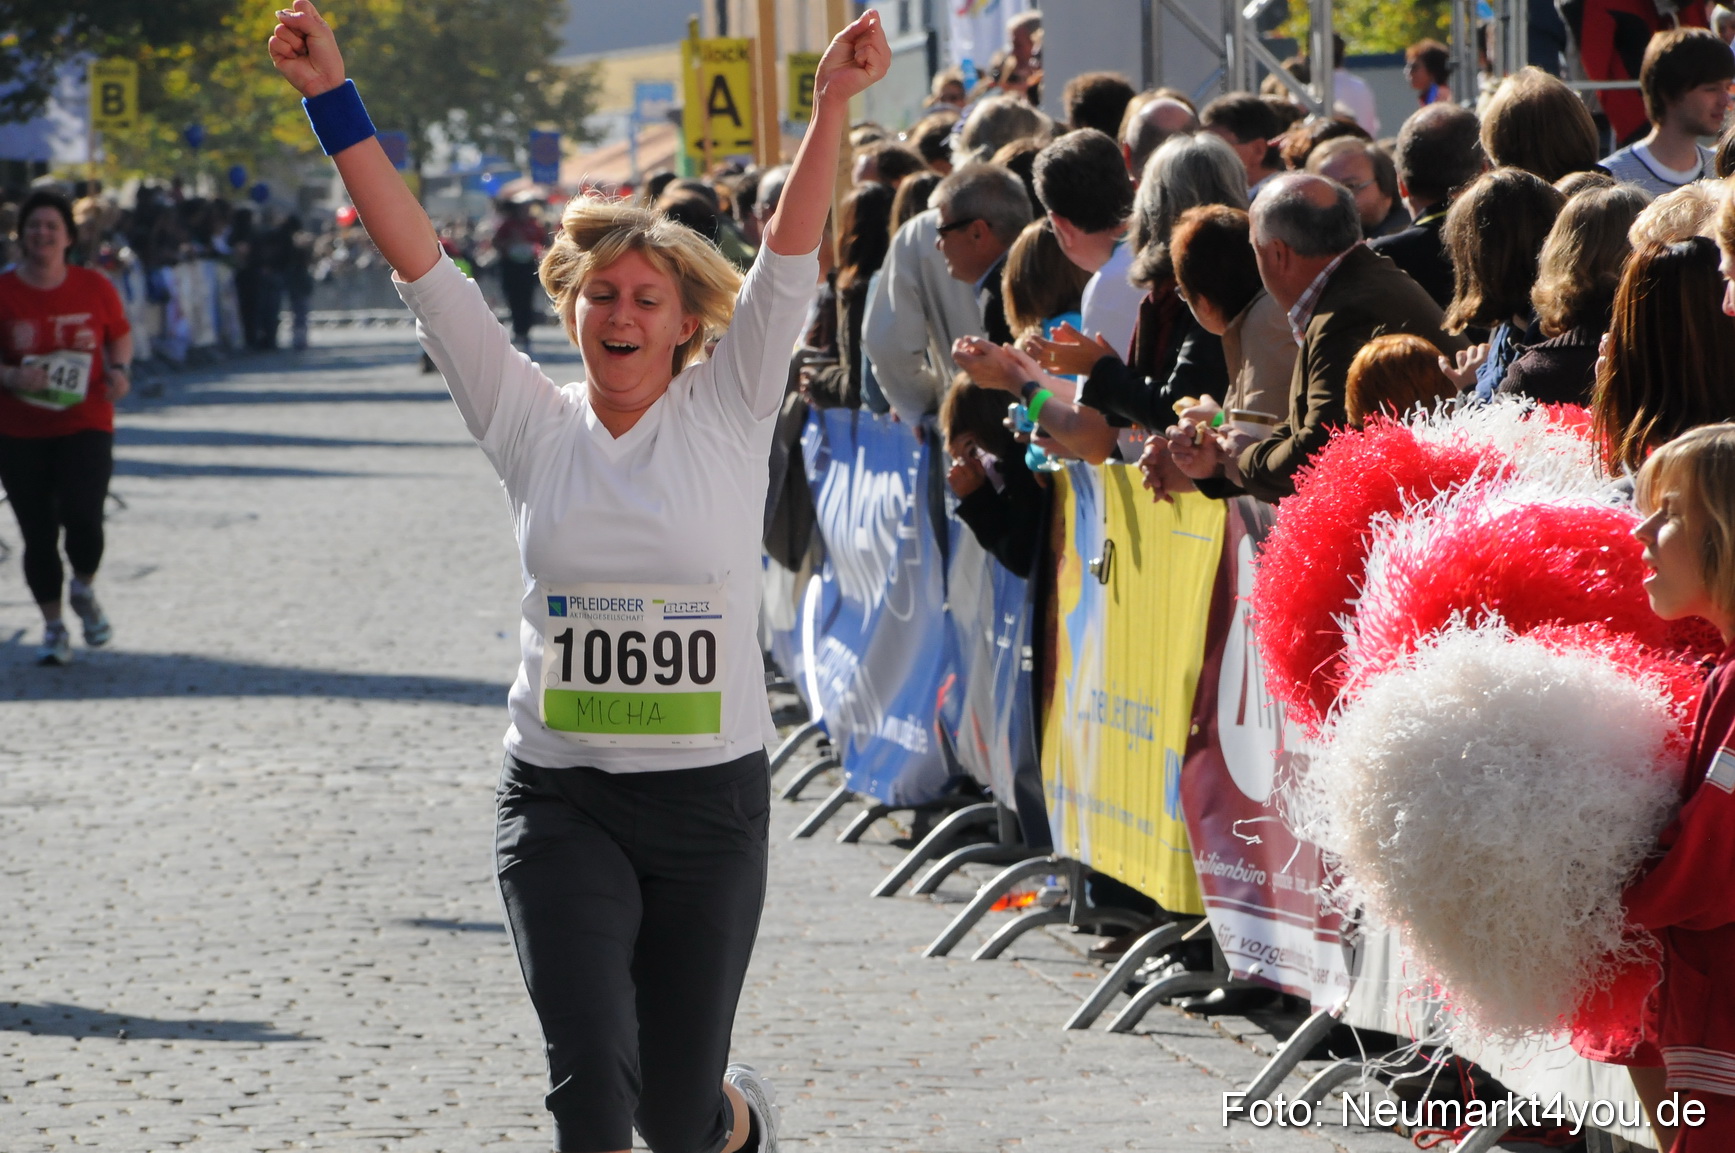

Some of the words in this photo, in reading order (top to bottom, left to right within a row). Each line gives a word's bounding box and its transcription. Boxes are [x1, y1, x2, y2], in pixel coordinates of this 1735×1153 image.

[101, 82, 125, 117] B
[707, 74, 742, 127] A
[43, 363, 80, 390] 48
[569, 595, 644, 612] PFLEIDERER
[553, 627, 716, 686] 10690
[577, 696, 665, 727] MICHA
